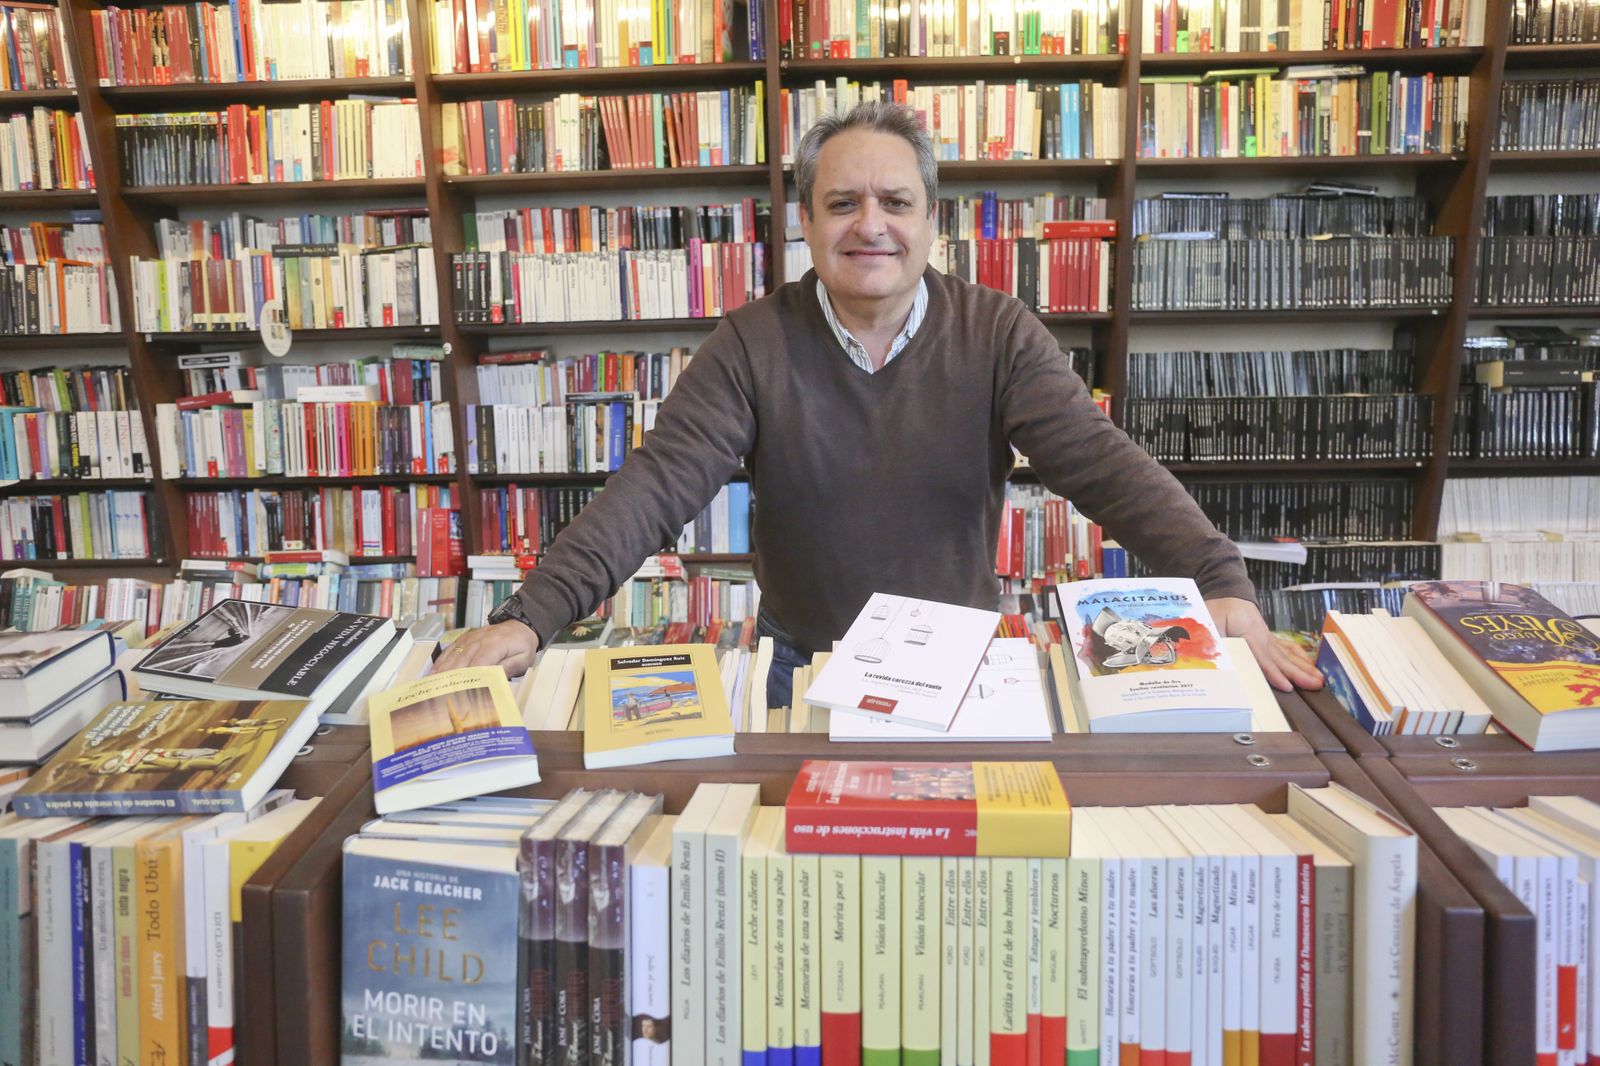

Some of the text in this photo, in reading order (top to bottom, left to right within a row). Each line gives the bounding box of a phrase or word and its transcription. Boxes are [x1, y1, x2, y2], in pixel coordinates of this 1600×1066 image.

[312, 108, 320, 142] MANKELL
[1077, 595, 1188, 606] MALACITANUS
[336, 622, 358, 640] VIDA
[342, 626, 368, 648] Landero
[354, 616, 368, 625] LA
[1494, 630, 1548, 640] JUEGO
[287, 636, 339, 686] NEGOCIABLE
[873, 672, 891, 681] ruvida
[892, 677, 915, 685] carezza
[398, 678, 480, 702] Leche caliente
[46, 800, 71, 809] piedra
[794, 824, 950, 839] La vida instrucciones de uso
[119, 869, 130, 916] cinta negra
[373, 875, 482, 901] JACK REACHER
[414, 871, 448, 881] HISTORIA
[716, 866, 726, 895] (tomo
[775, 867, 786, 895] polar
[800, 870, 812, 897] polar
[837, 881, 846, 899] por
[978, 870, 988, 894] ellos
[1003, 870, 1014, 916] hombres
[1030, 868, 1039, 915] temblores
[1105, 870, 1114, 897] madre
[1127, 867, 1136, 896] madre
[1150, 866, 1159, 917] Las afueras
[1176, 867, 1185, 919] Las afueras
[144, 860, 160, 942] Todo Ubú
[748, 870, 759, 945] Leche caliente
[945, 869, 955, 925] Entre ellos
[962, 870, 972, 926] Entre ellos
[978, 898, 988, 926] Entre
[1049, 873, 1059, 928] Nocturnos
[1196, 867, 1205, 925] Magnetizado
[1211, 866, 1220, 923] Magnetizado
[1272, 867, 1282, 938] Tierra de campos
[394, 902, 462, 942] LEE
[680, 840, 691, 986] Los diarios de Emilio Renzi
[716, 900, 726, 930] Renzi
[876, 871, 886, 955] Visión binocular
[915, 872, 925, 956] Visión binocular
[1003, 920, 1014, 935] los
[716, 932, 726, 967] Emilio
[775, 941, 785, 953] de
[801, 942, 810, 955] de
[1003, 937, 1014, 951] de
[1030, 926, 1040, 962] Estupor
[1078, 870, 1090, 1000] El submayordomo Minor
[1106, 928, 1116, 950] padre
[1127, 928, 1138, 951] padre
[367, 940, 485, 985] CHILD
[1003, 953, 1014, 967] fin
[1003, 970, 1014, 980] el
[1301, 864, 1312, 1051] La cabeza perdida de Damasceno Monteiro
[1388, 854, 1402, 1065] McCourt Las Cenizas de Ángela
[152, 951, 164, 1021] Alfred Jarry
[716, 970, 726, 983] de
[775, 956, 785, 1007] Memorias
[801, 958, 811, 1009] Memorias
[1127, 974, 1136, 1014] Honrarás
[364, 989, 486, 1026] MORIR EN
[716, 986, 726, 1022] diarios
[1003, 992, 1014, 1030] Laëtitia
[1105, 975, 1114, 1016] Honrarás
[352, 1014, 497, 1056] EL INTENTO
[716, 1024, 726, 1044] Los
